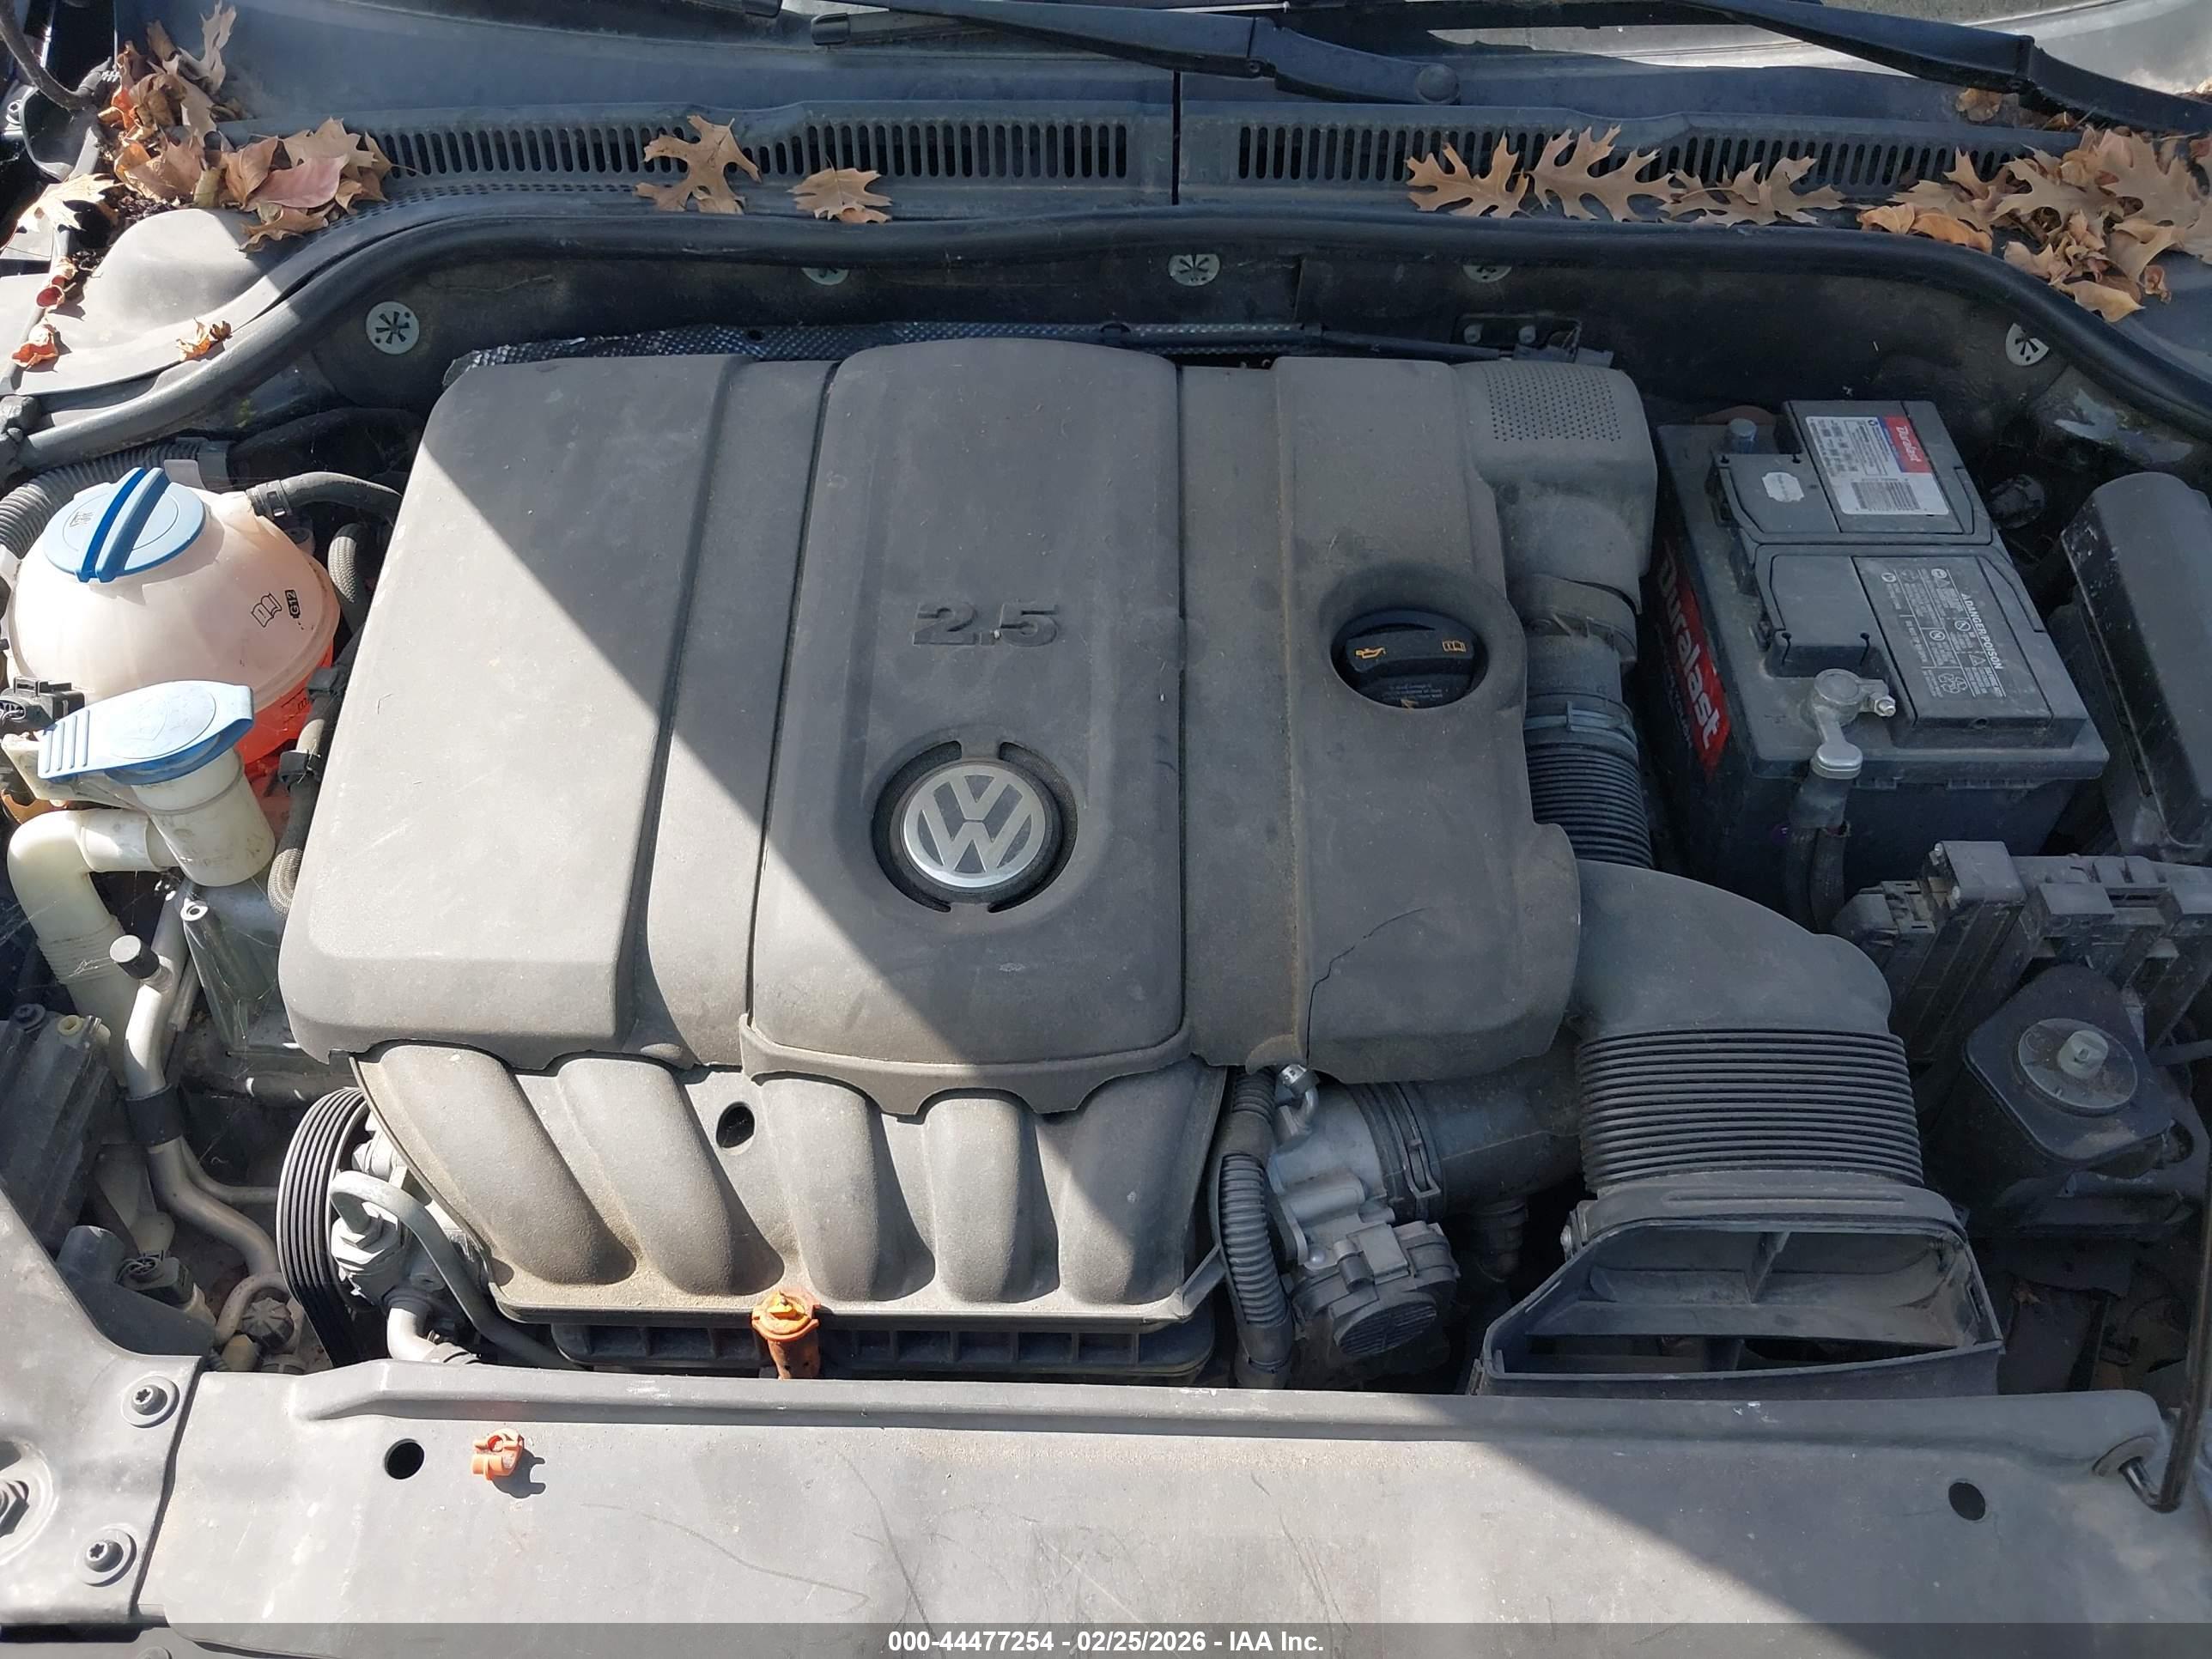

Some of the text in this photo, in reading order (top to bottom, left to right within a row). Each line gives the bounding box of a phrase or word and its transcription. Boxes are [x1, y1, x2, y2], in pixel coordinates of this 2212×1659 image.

[1895, 425, 1922, 463] Duralast
[287, 591, 300, 615] G12
[914, 601, 1058, 647] 2.5
[1658, 539, 1721, 750] Duralast
[1966, 599, 2004, 670] DANGER/POISON
[908, 766, 1042, 884] VW
